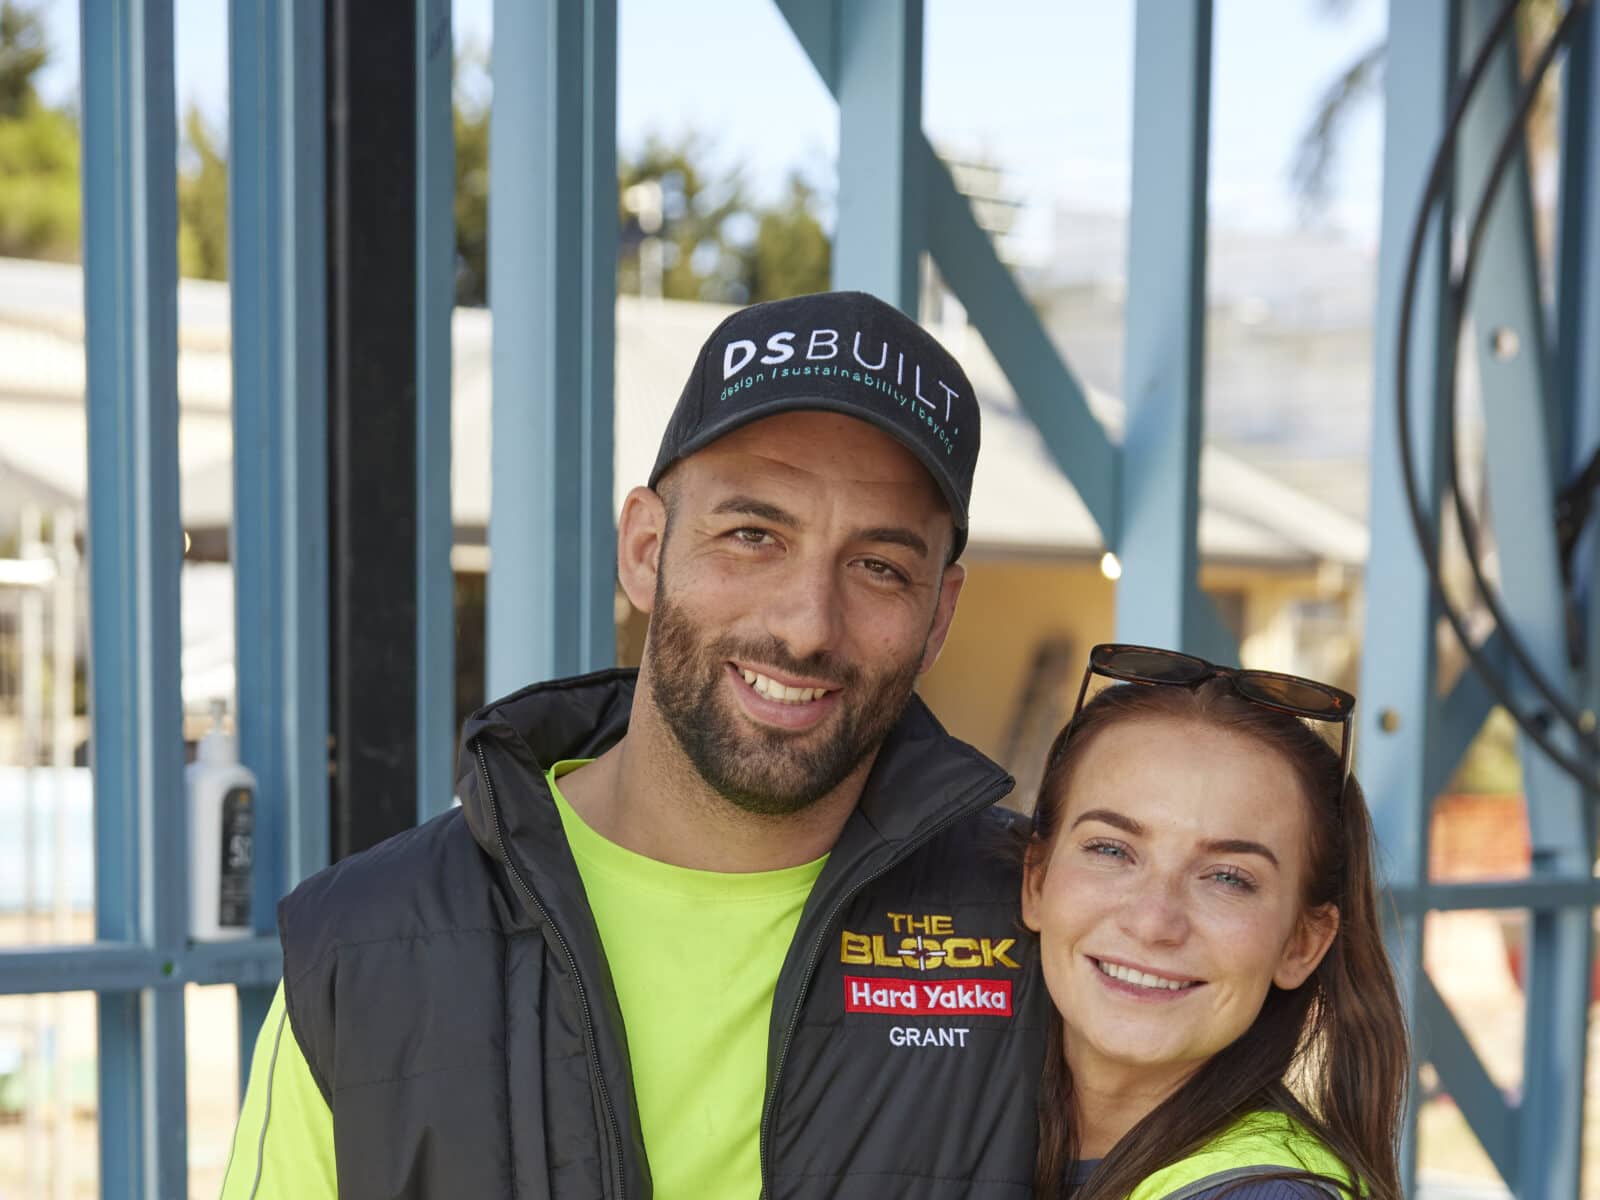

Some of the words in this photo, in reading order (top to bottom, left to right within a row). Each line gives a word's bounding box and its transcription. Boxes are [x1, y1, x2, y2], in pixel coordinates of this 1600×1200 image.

[887, 911, 955, 935] THE
[840, 930, 1022, 969] BLOCK
[851, 981, 918, 1010] Hard
[923, 984, 1007, 1010] Yakka
[889, 1026, 970, 1048] GRANT
